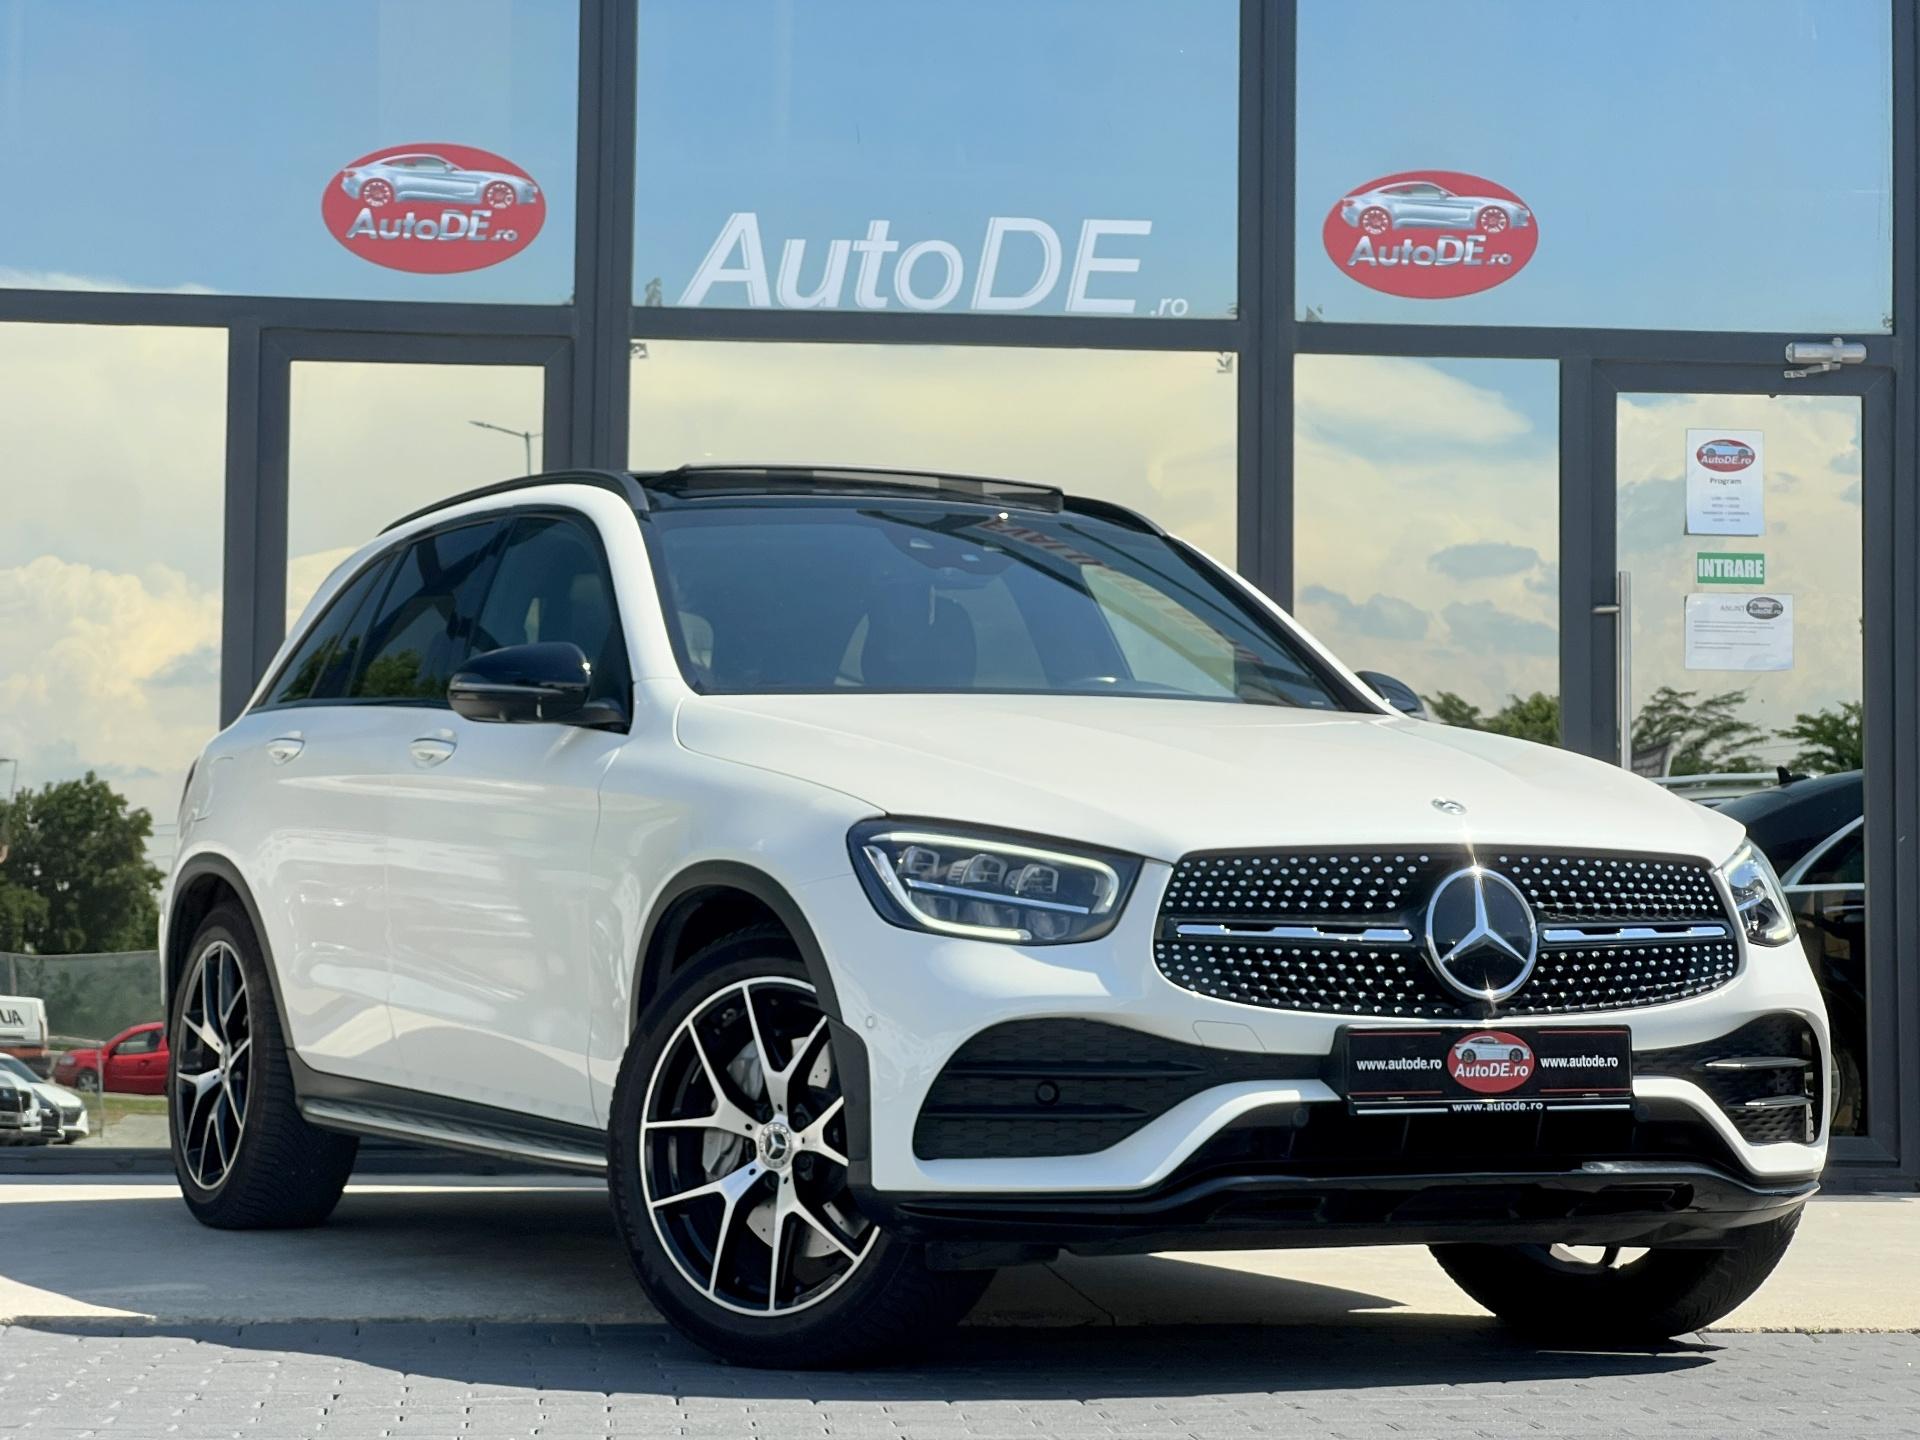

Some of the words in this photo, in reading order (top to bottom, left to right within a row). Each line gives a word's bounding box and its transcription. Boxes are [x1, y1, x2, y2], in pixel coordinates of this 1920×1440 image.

[1701, 455, 1752, 465] AutoDE.ro
[1710, 477, 1742, 486] Program
[1698, 558, 1763, 578] INTRARE
[1356, 1057, 1442, 1071] www.autode.ro
[1540, 1055, 1619, 1068] www.autode.ro
[1454, 1062, 1529, 1078] AutoDE.ro
[1452, 1101, 1544, 1112] www.autode.ro
